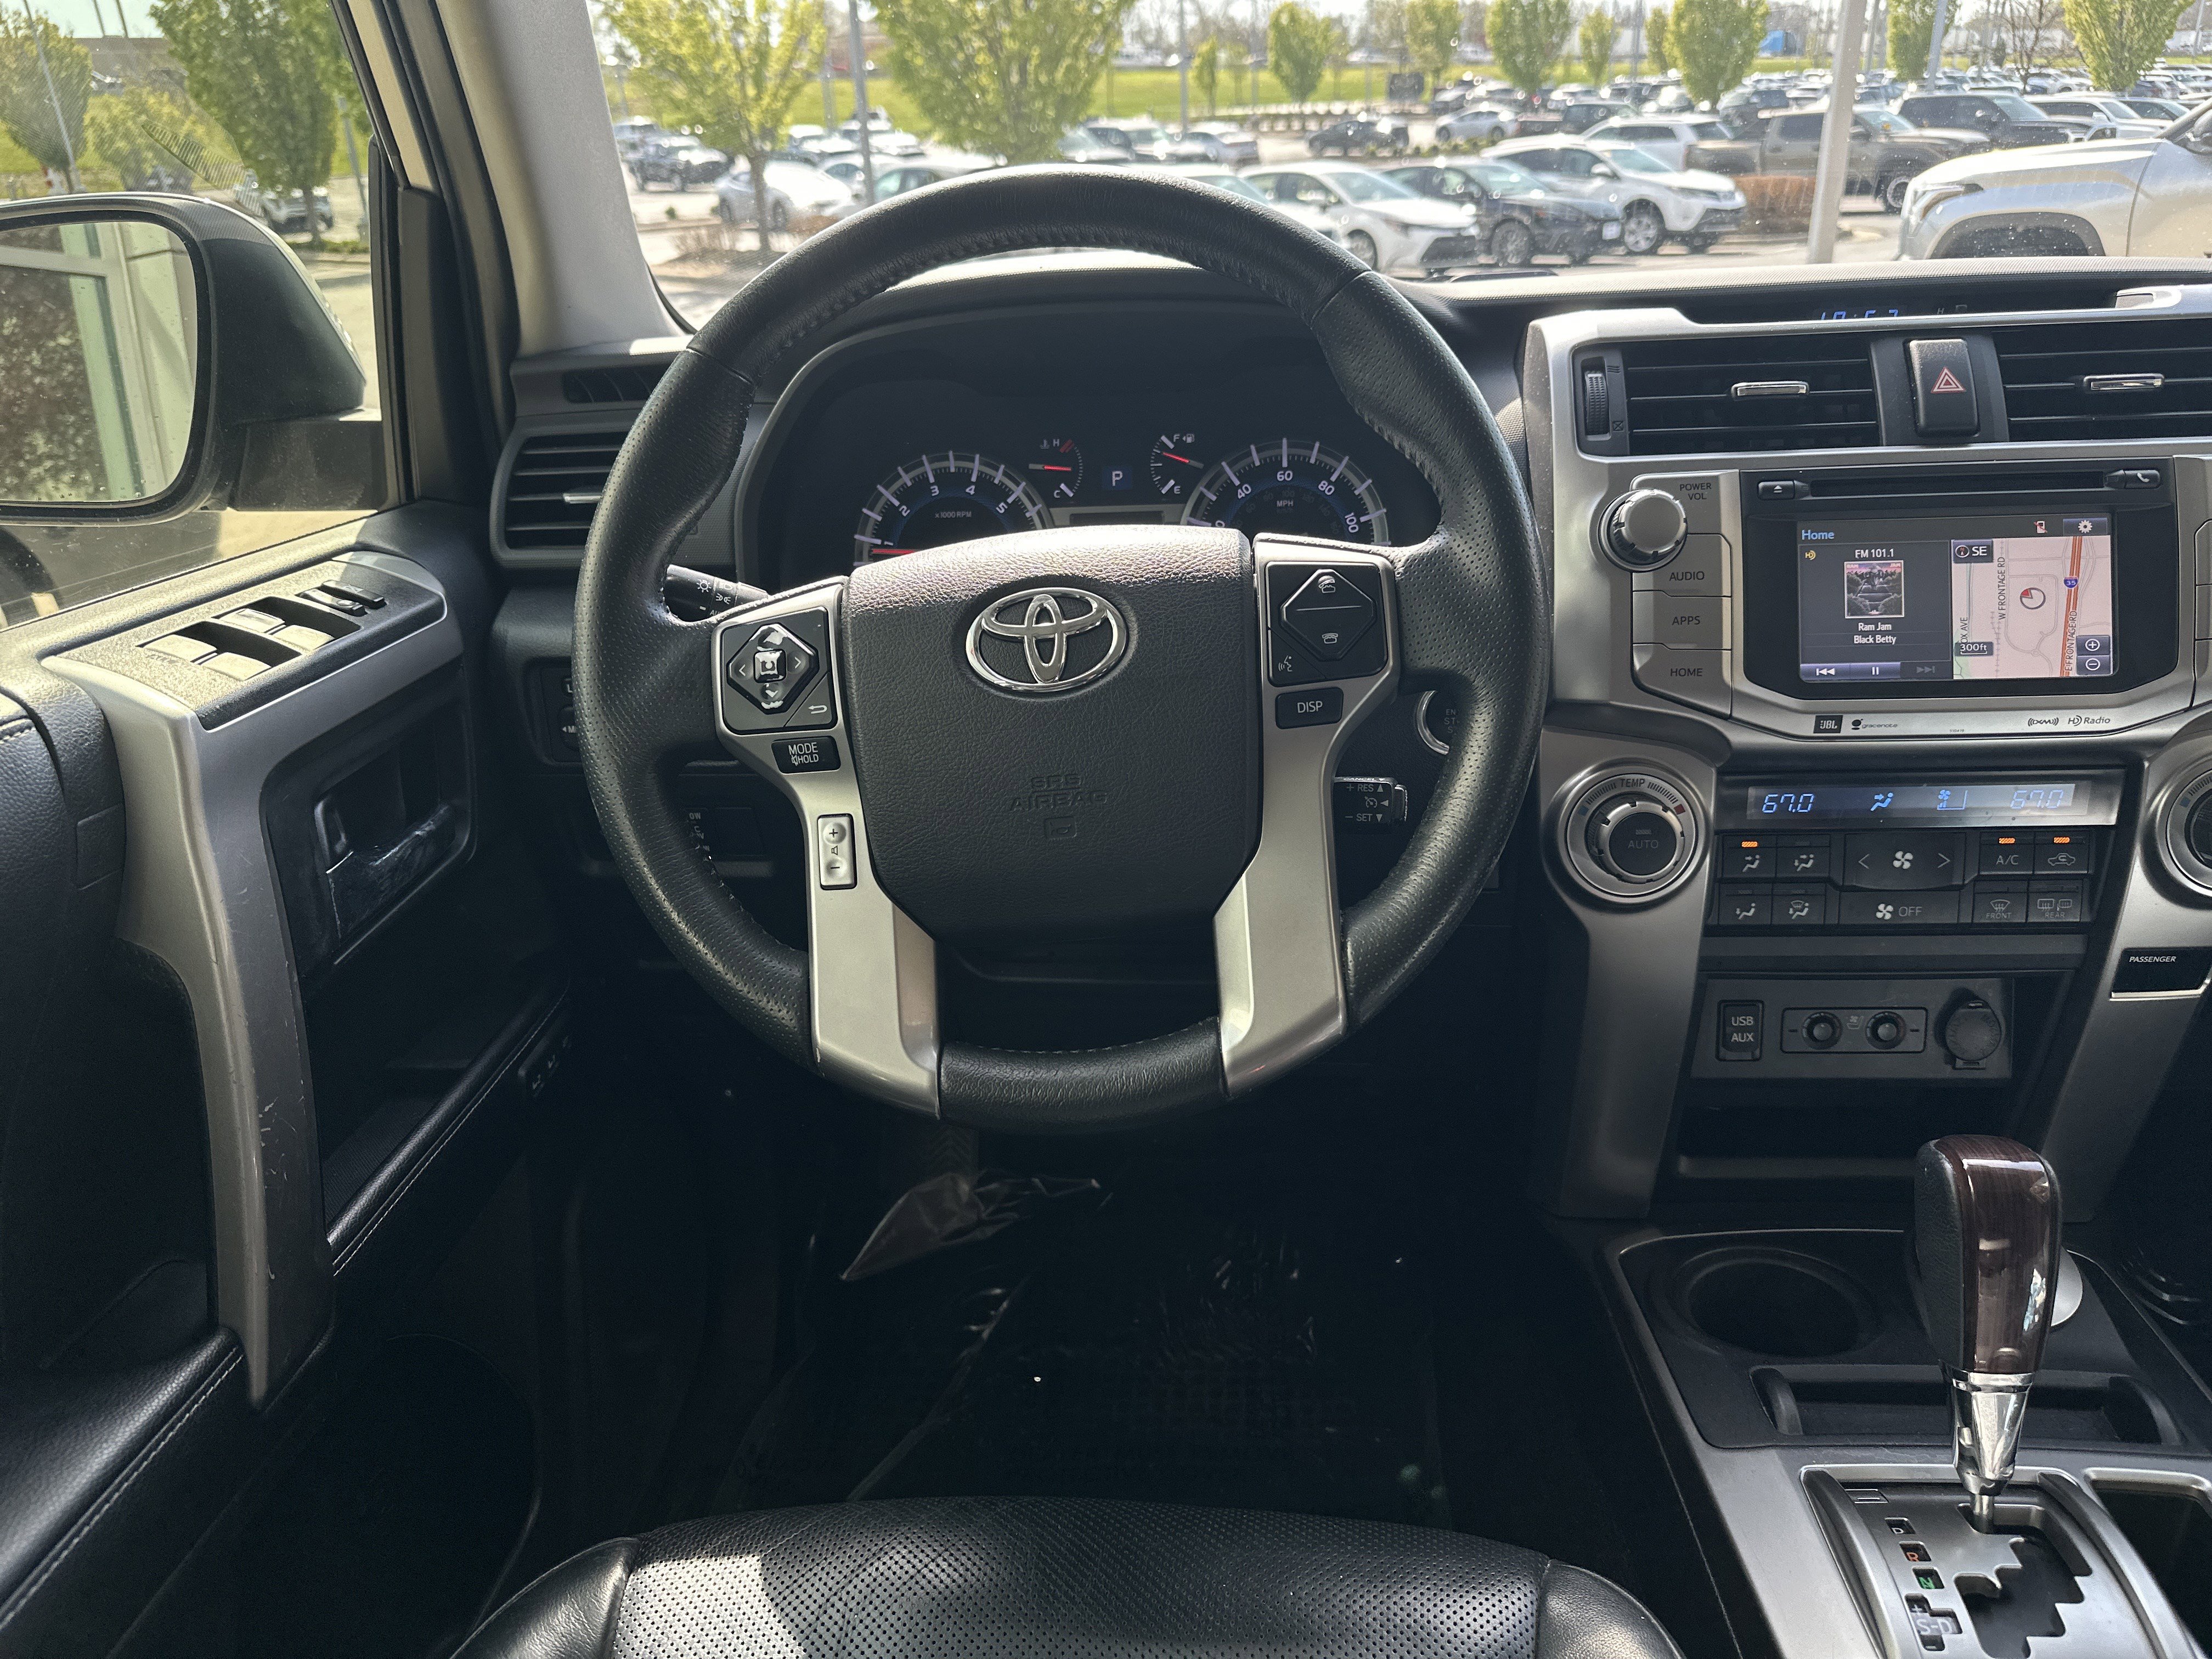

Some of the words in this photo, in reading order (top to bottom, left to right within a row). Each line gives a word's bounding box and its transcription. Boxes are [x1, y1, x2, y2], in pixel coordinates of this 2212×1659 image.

[1111, 470, 1123, 487] P
[1276, 470, 1293, 482] 60
[930, 485, 939, 496] 3
[966, 484, 975, 495] 4
[1237, 484, 1252, 499] 40
[1318, 481, 1335, 495] 80
[1679, 482, 1712, 492] POWER
[1053, 490, 1061, 498] C
[1688, 492, 1707, 500] VOL
[898, 505, 911, 517] 2
[996, 503, 1008, 514] 5
[1344, 512, 1359, 533] 100
[1801, 529, 1835, 540] Home
[1855, 549, 1869, 558] FM
[1871, 548, 1894, 558] 101.1
[1972, 546, 1988, 556] SE
[1997, 556, 2006, 568] RD
[1669, 571, 1705, 582] AUDIO
[1997, 569, 2006, 612] FRONTAGE
[1672, 616, 1701, 625] APPS
[2069, 610, 2078, 622] RD
[1858, 622, 1875, 631] Ram
[1876, 622, 1892, 631] Jam
[1960, 616, 1968, 630] AVE
[1854, 635, 1874, 644] Black
[1876, 634, 1897, 645] Betty
[2065, 624, 2076, 664] FRONTAGE
[1670, 668, 1703, 678] HOME
[1297, 700, 1323, 714] DISP
[1820, 720, 1838, 730] JBL
[788, 742, 819, 755] MODE
[797, 754, 819, 764] HOLD
[1357, 783, 1374, 792] RES
[1620, 777, 1646, 788] TEMP
[1762, 793, 1815, 813] 67.0
[2010, 789, 2064, 809] 67.0
[1356, 813, 1373, 822] SET
[1628, 839, 1658, 849] AUTO
[1995, 854, 2019, 865] A/C
[1898, 905, 1922, 917] OFF
[1731, 1015, 1754, 1026] USB
[1731, 1031, 1754, 1042] AUX
[1906, 1551, 1920, 1562] R
[1918, 1577, 1936, 1589] N
